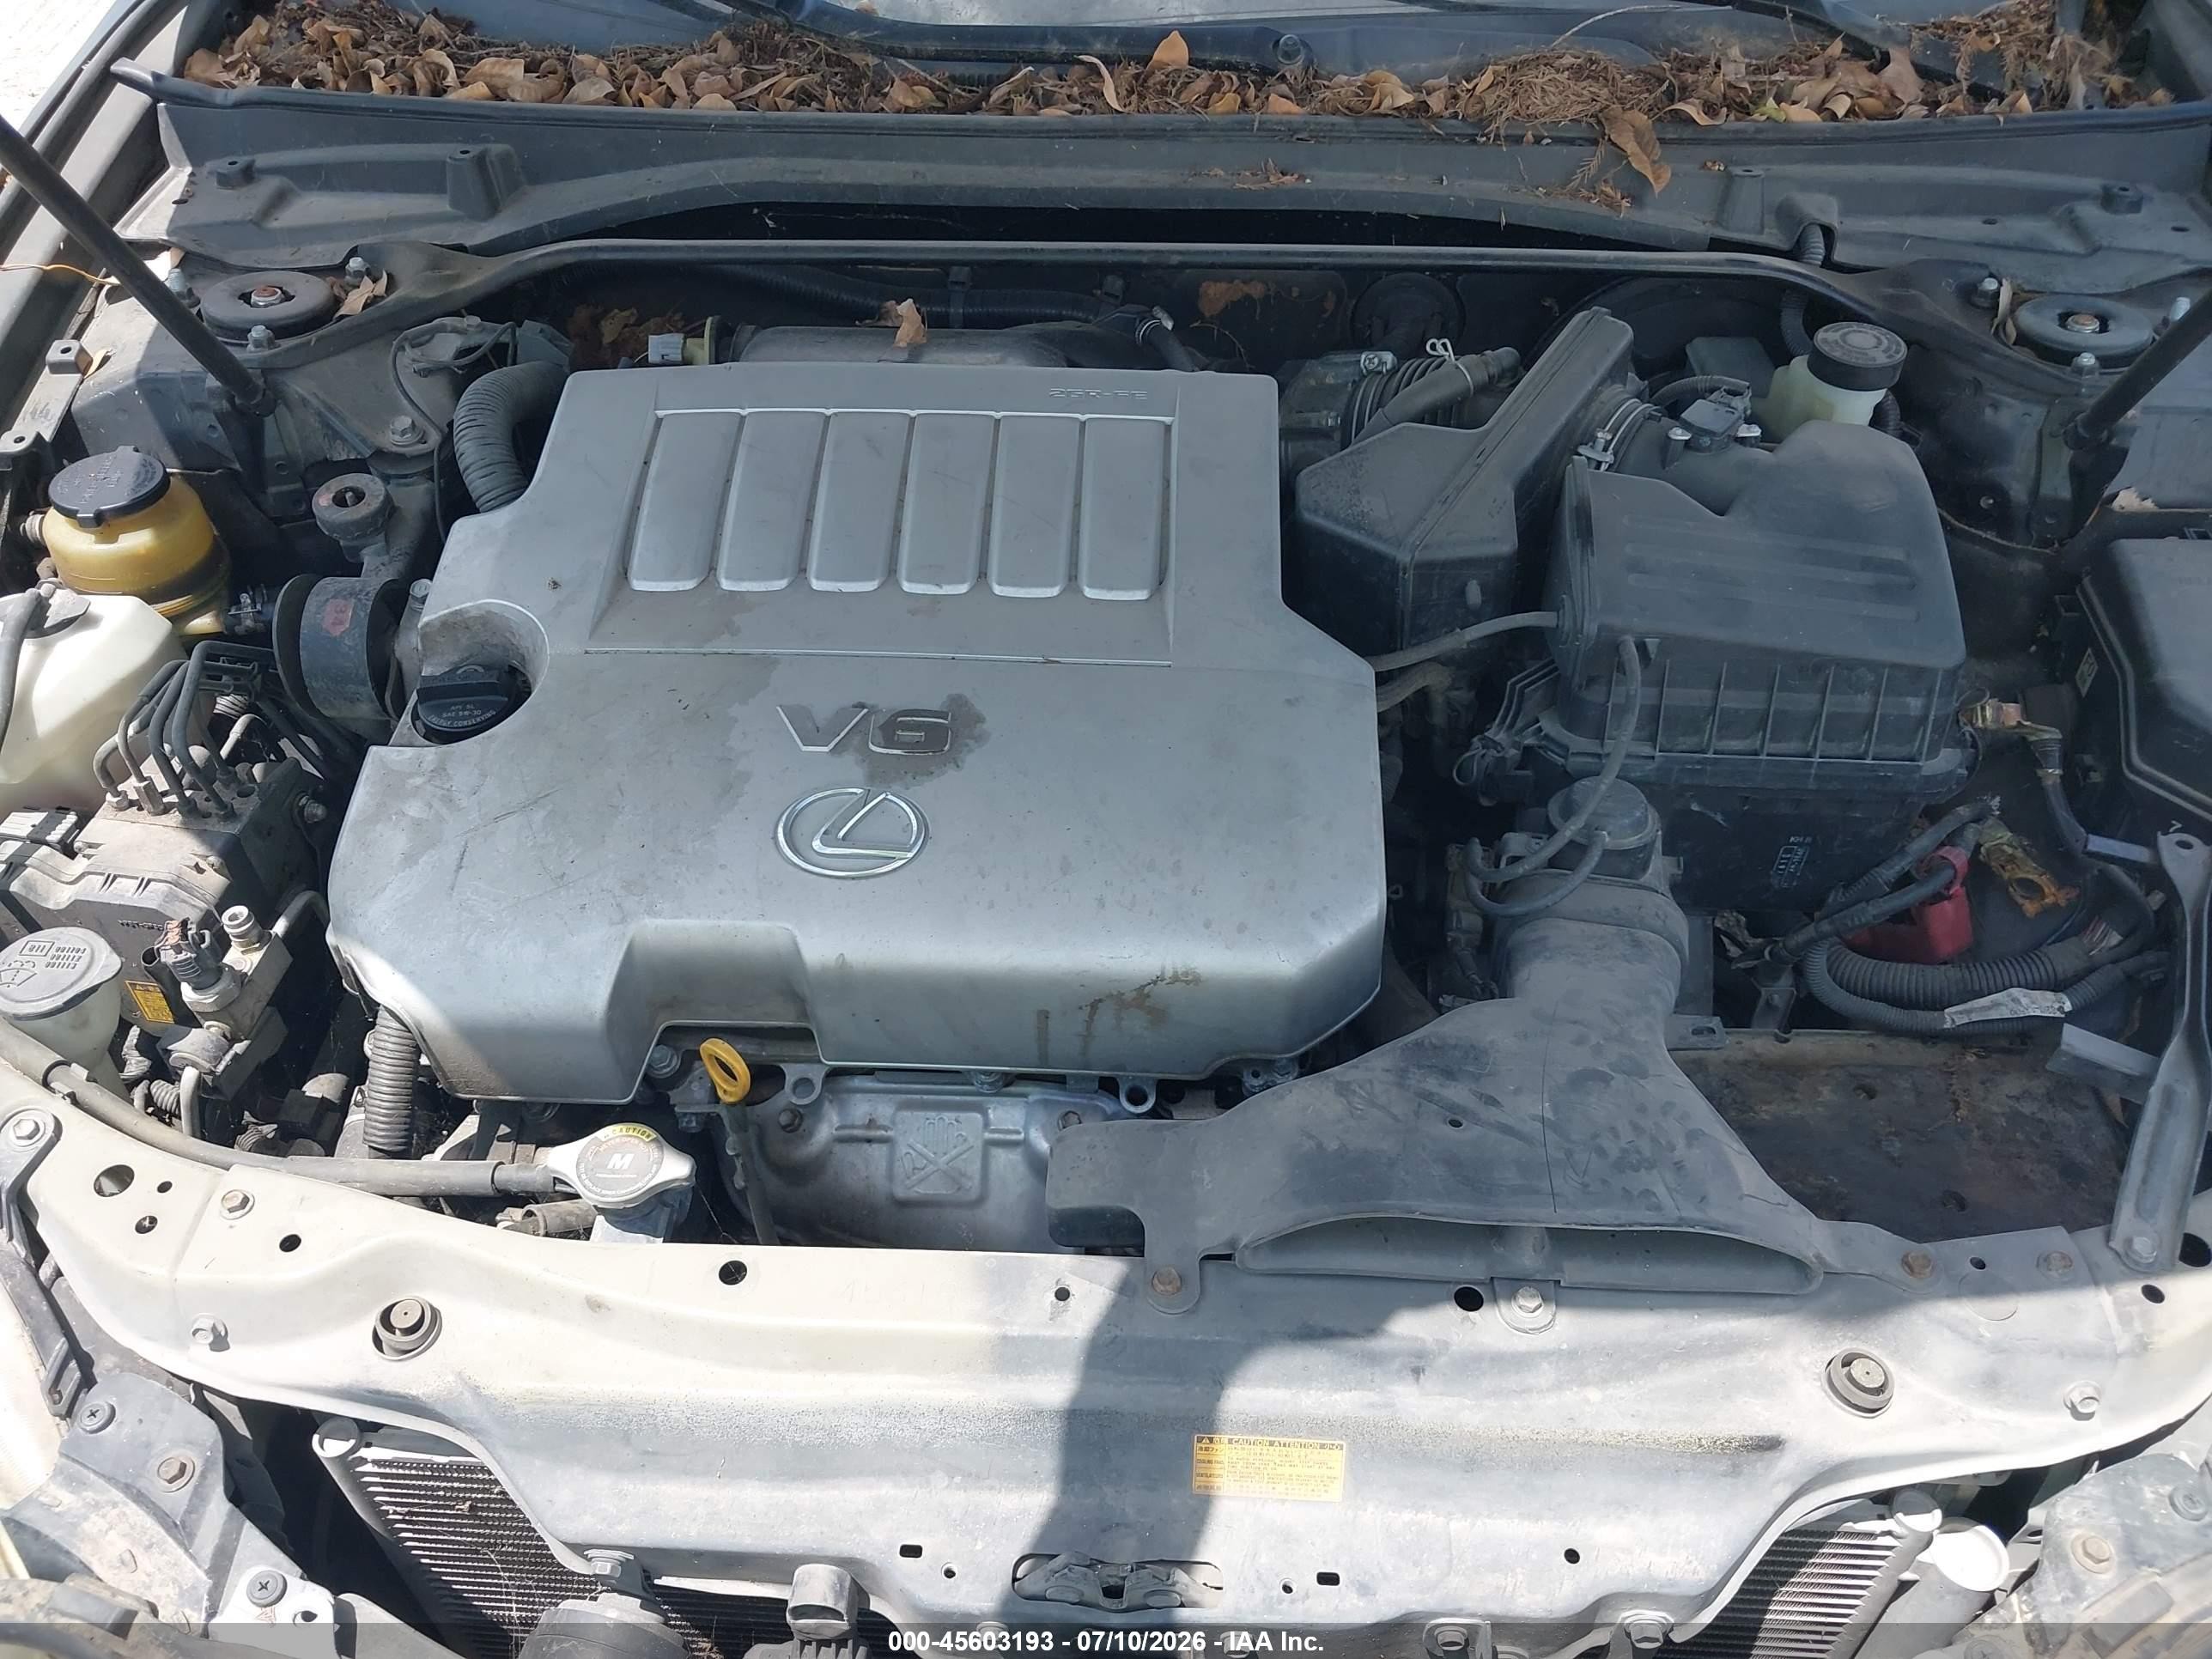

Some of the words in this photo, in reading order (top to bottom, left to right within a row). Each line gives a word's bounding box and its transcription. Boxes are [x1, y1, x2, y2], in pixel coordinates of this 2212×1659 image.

[775, 704, 952, 756] V6
[612, 1126, 653, 1140] CAUTION
[606, 1153, 635, 1170] M
[1232, 1438, 1270, 1447] CAUTION
[1275, 1440, 1320, 1449] ATTENTION
